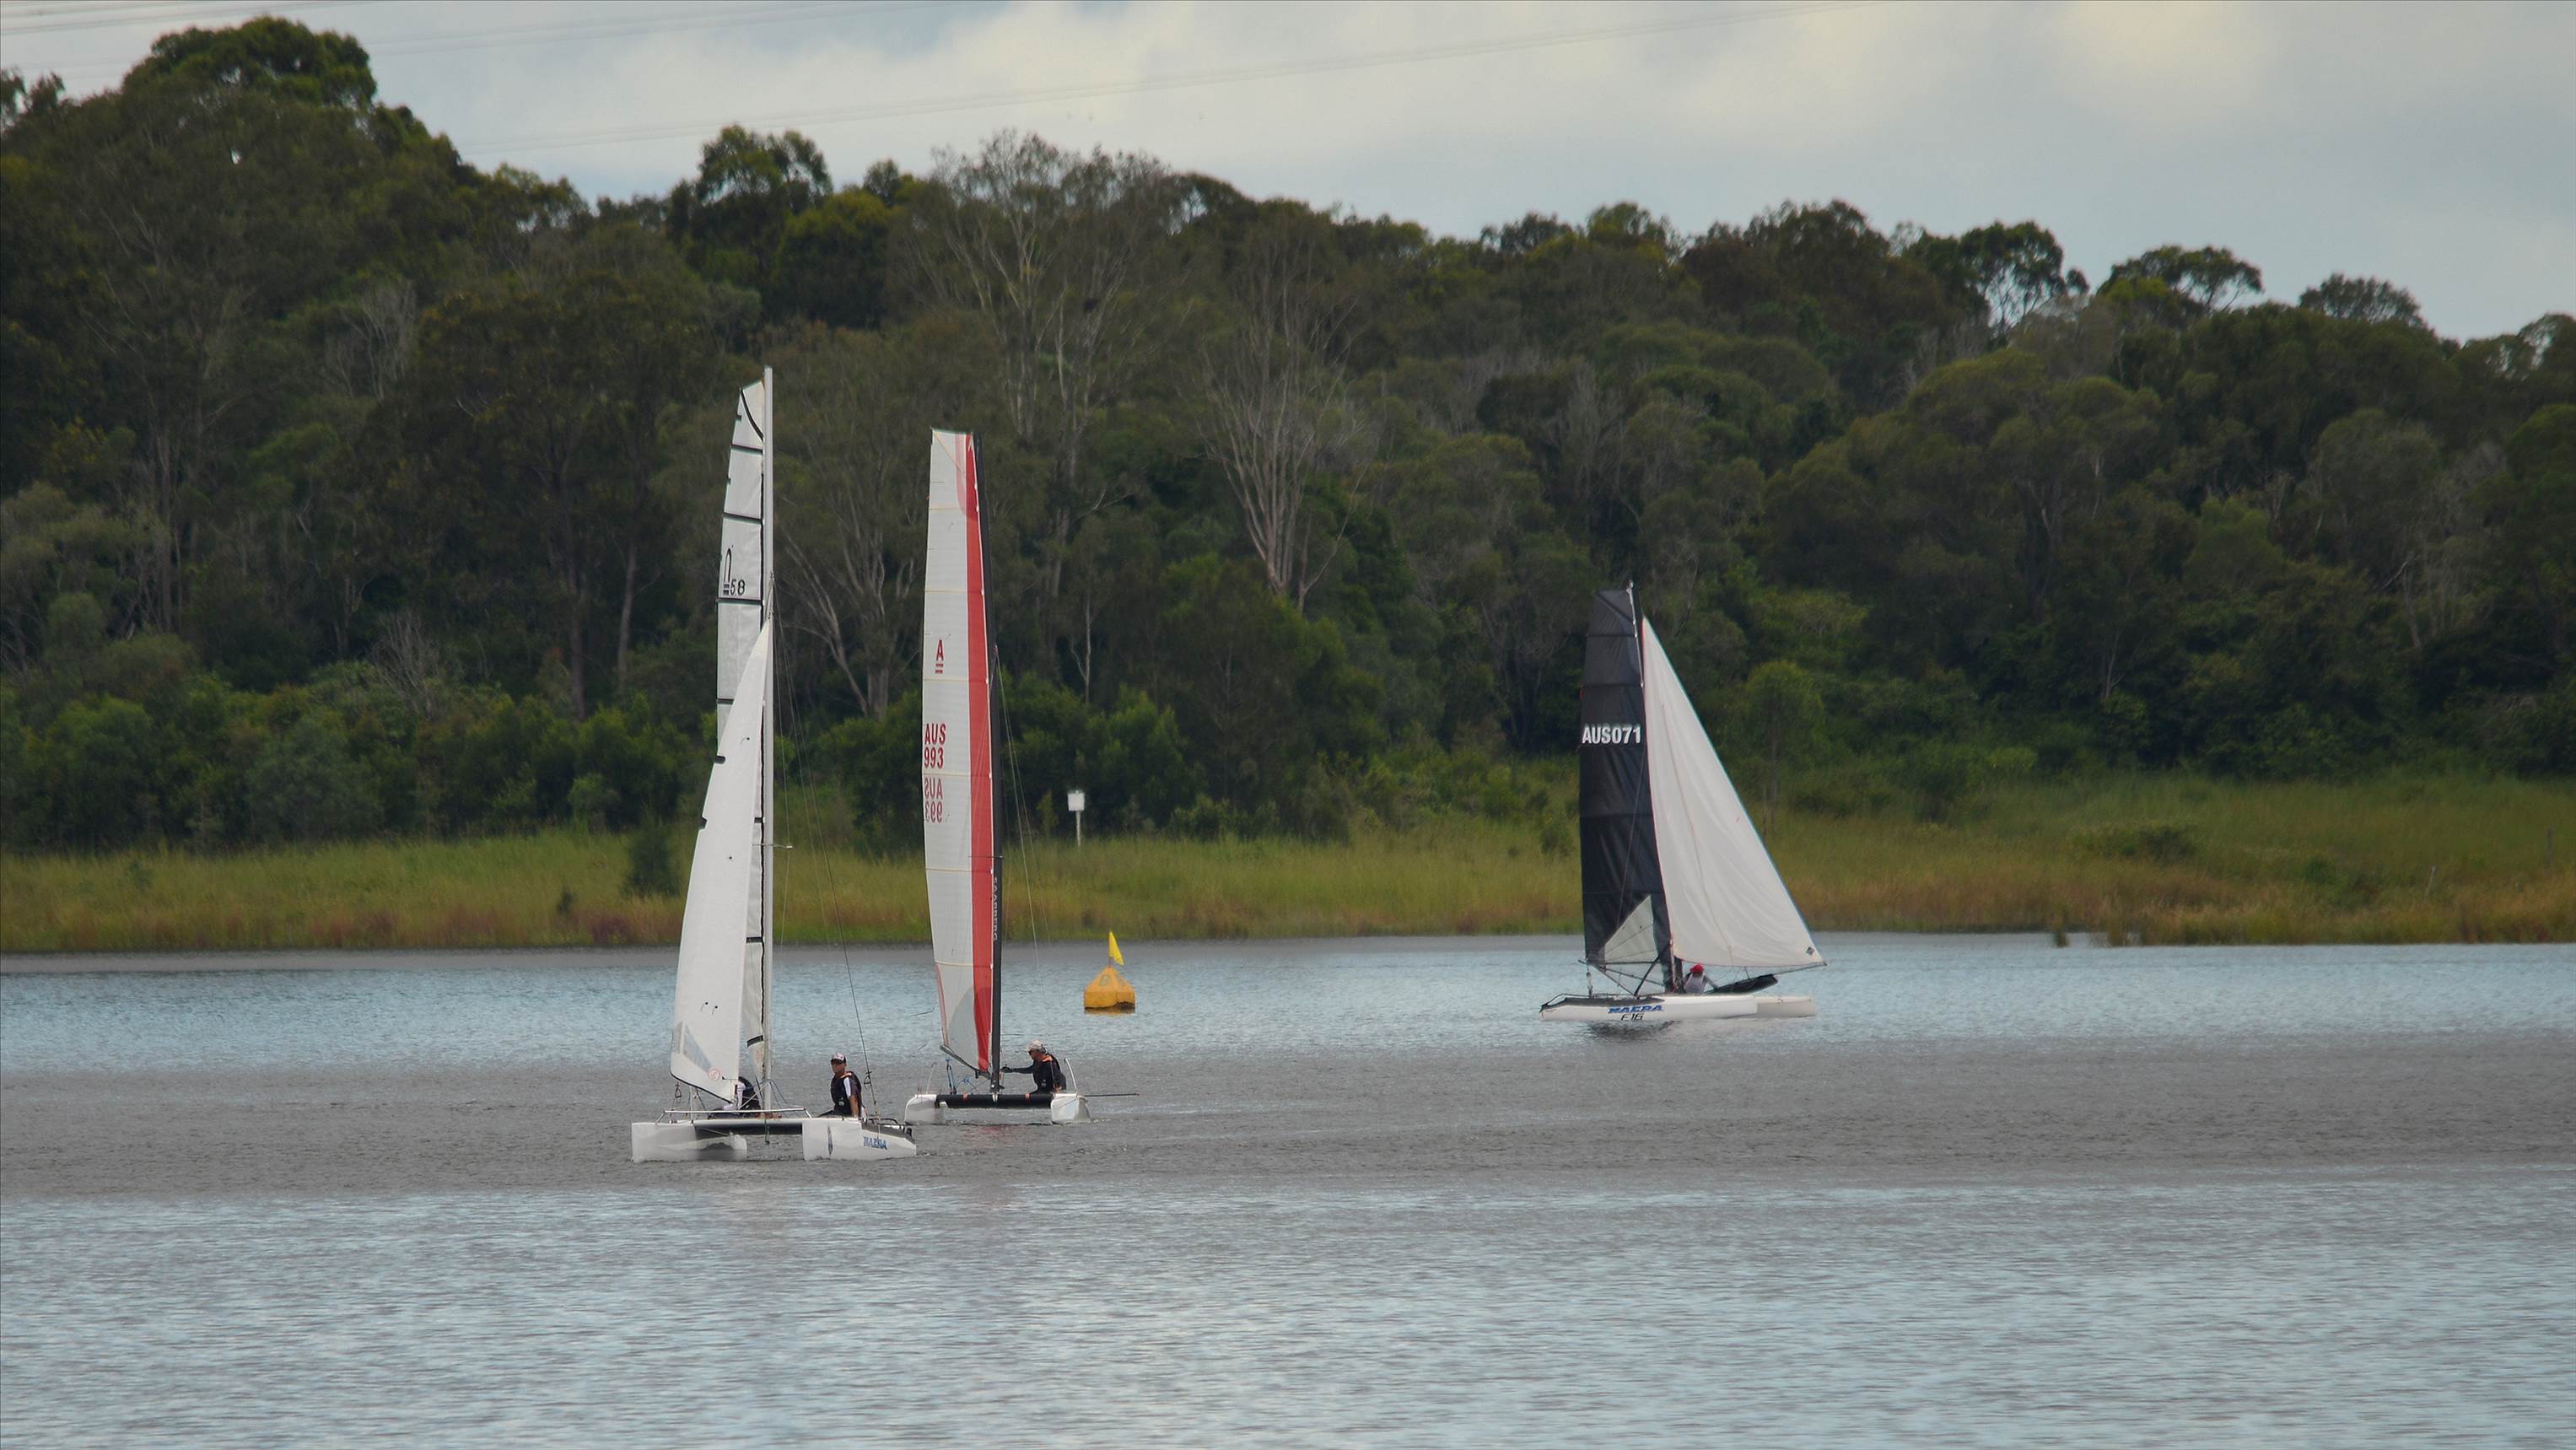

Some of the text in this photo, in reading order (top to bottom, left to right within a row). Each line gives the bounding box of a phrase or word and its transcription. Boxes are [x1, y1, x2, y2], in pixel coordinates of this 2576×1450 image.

[935, 639, 944, 661] A
[924, 723, 946, 745] AUS
[1582, 725, 1641, 744] AUS071
[924, 747, 944, 769] 993
